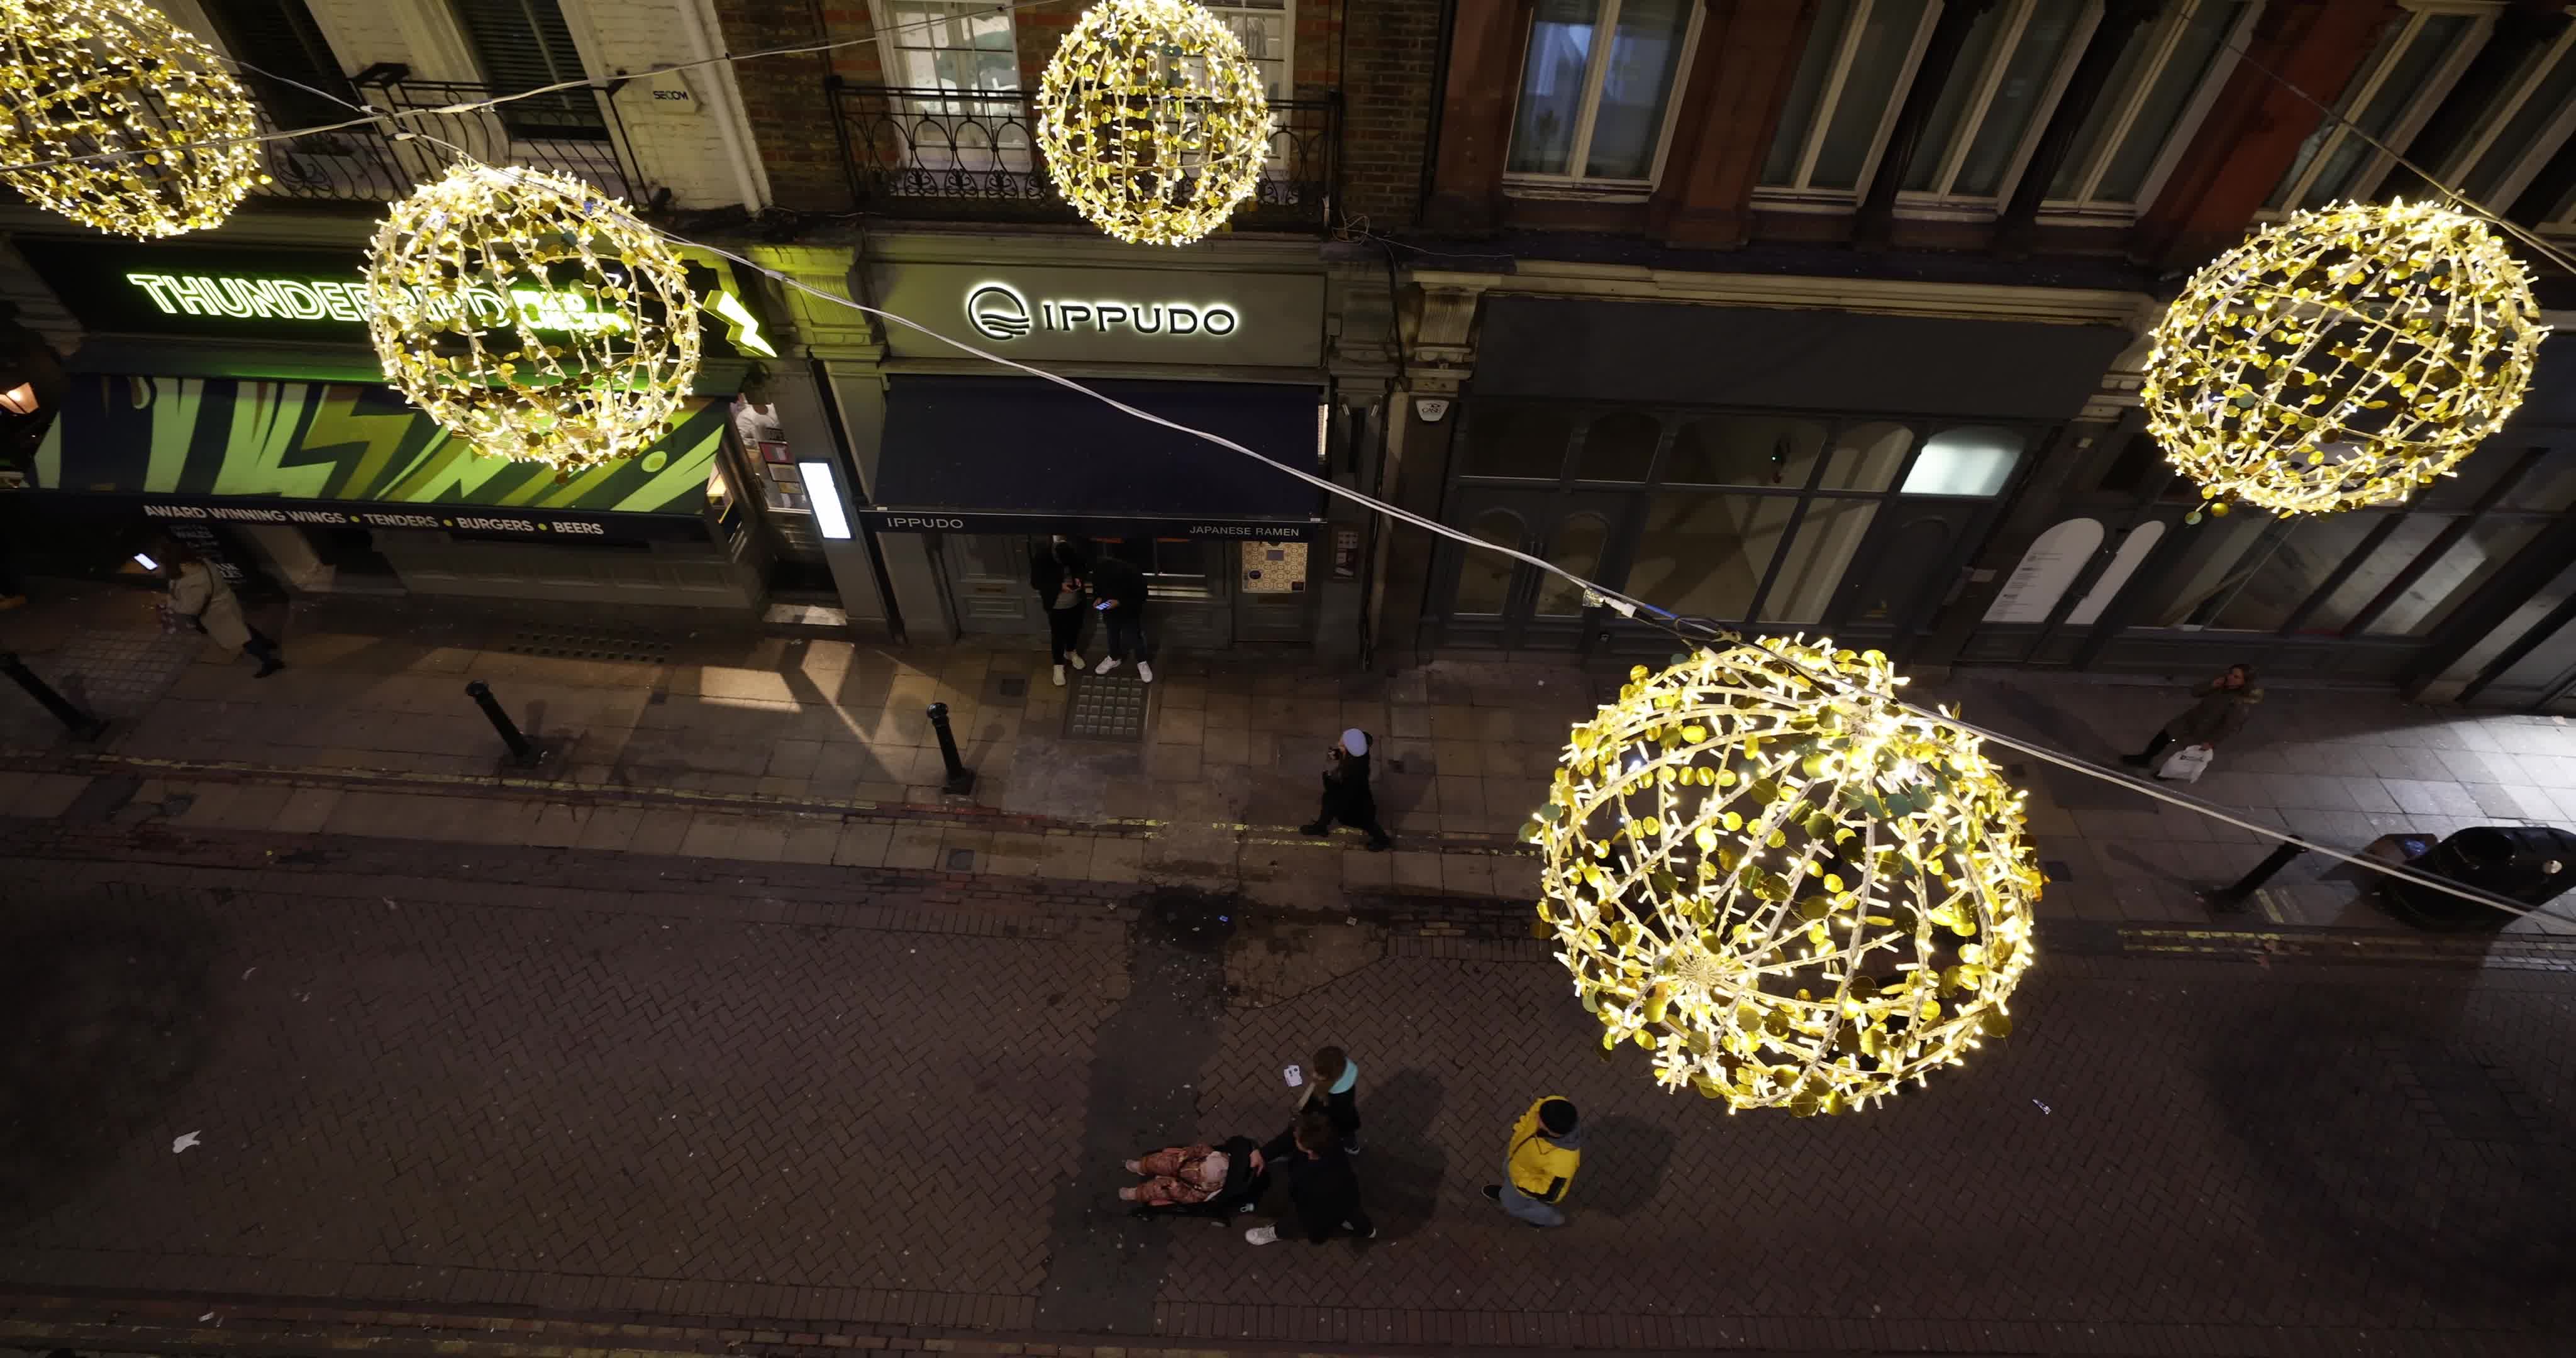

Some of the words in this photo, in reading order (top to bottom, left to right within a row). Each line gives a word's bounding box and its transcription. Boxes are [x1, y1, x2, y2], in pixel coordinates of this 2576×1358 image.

[652, 91, 689, 101] SECOM
[1043, 304, 1235, 336] IPPUDO
[143, 505, 208, 519] AWARD
[206, 507, 287, 522] WINNING
[286, 511, 347, 524] WINGS
[363, 514, 439, 528] TENDERS
[456, 517, 534, 532] BURGERS
[552, 522, 604, 535] BEERS
[887, 517, 963, 529] IPPUDO
[1189, 526, 1252, 535] JAPANESE
[1255, 527, 1299, 536] RAMEN
